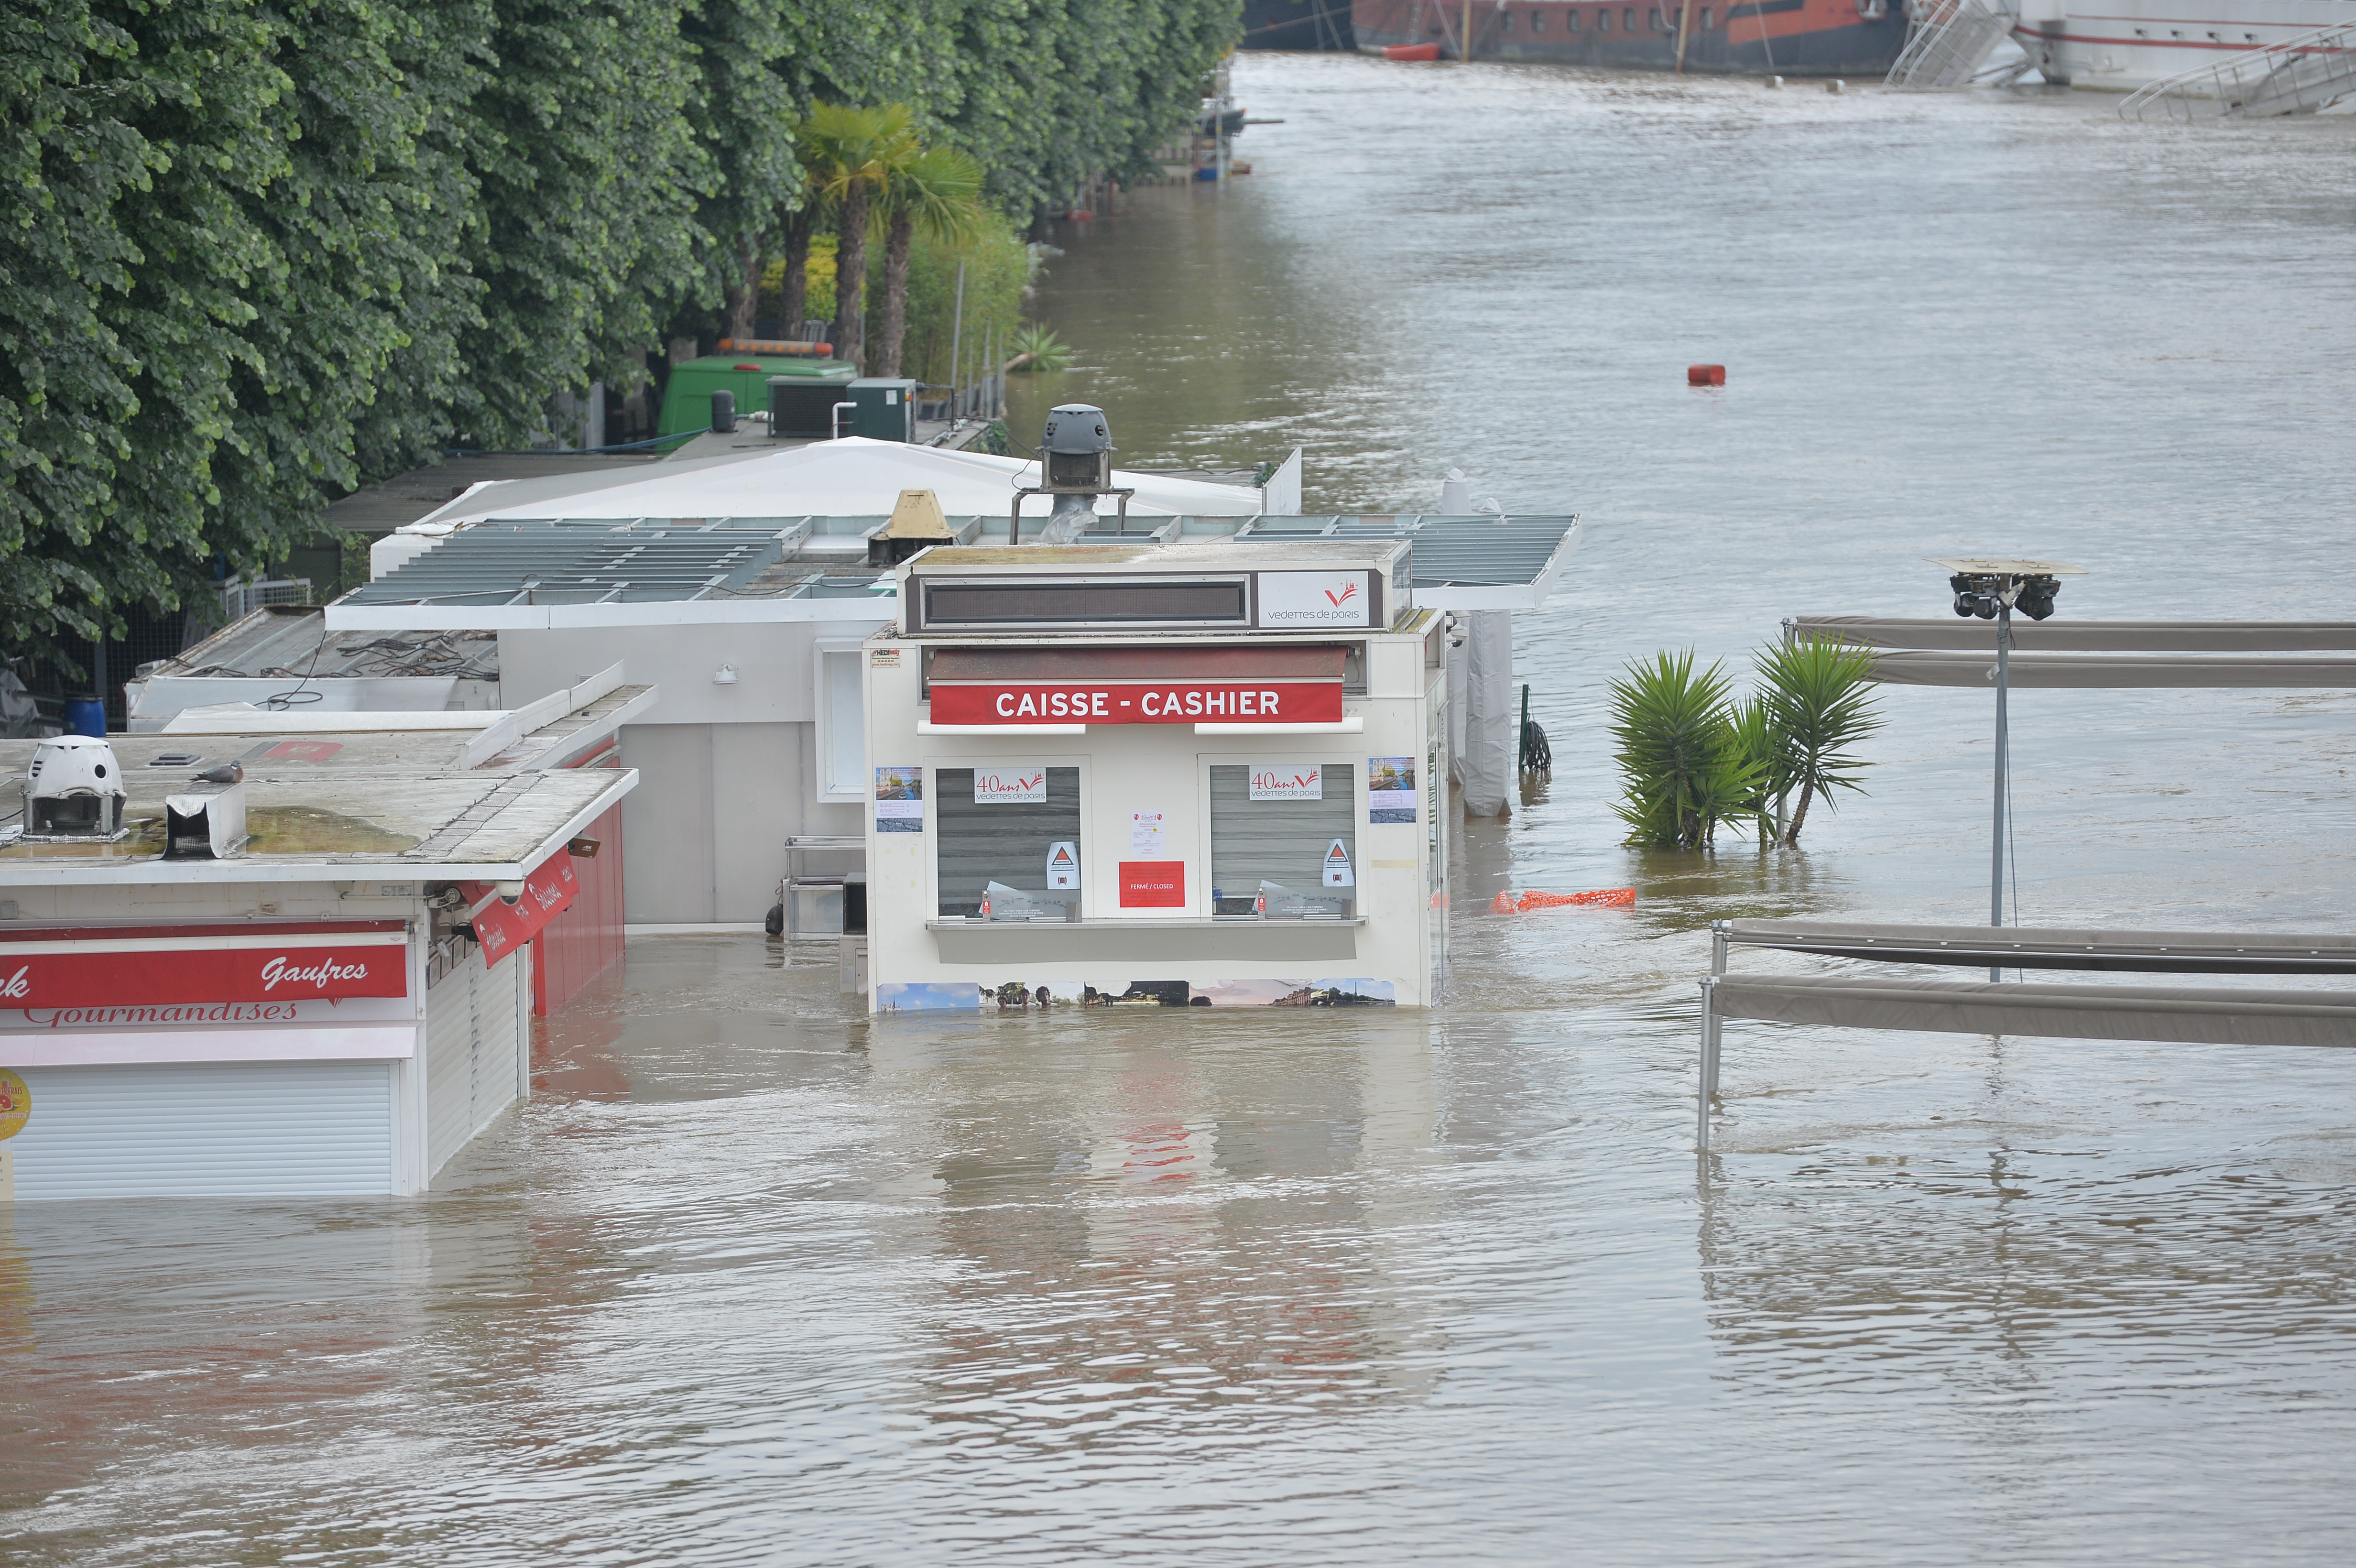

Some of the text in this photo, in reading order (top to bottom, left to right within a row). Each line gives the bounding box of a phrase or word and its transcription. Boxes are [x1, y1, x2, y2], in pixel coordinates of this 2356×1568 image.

[1317, 610, 1330, 618] de
[996, 693, 1109, 716] CAISSE
[1142, 691, 1279, 716] CASHIER
[261, 956, 368, 991] Gaufres
[8, 1087, 22, 1095] FRAIS
